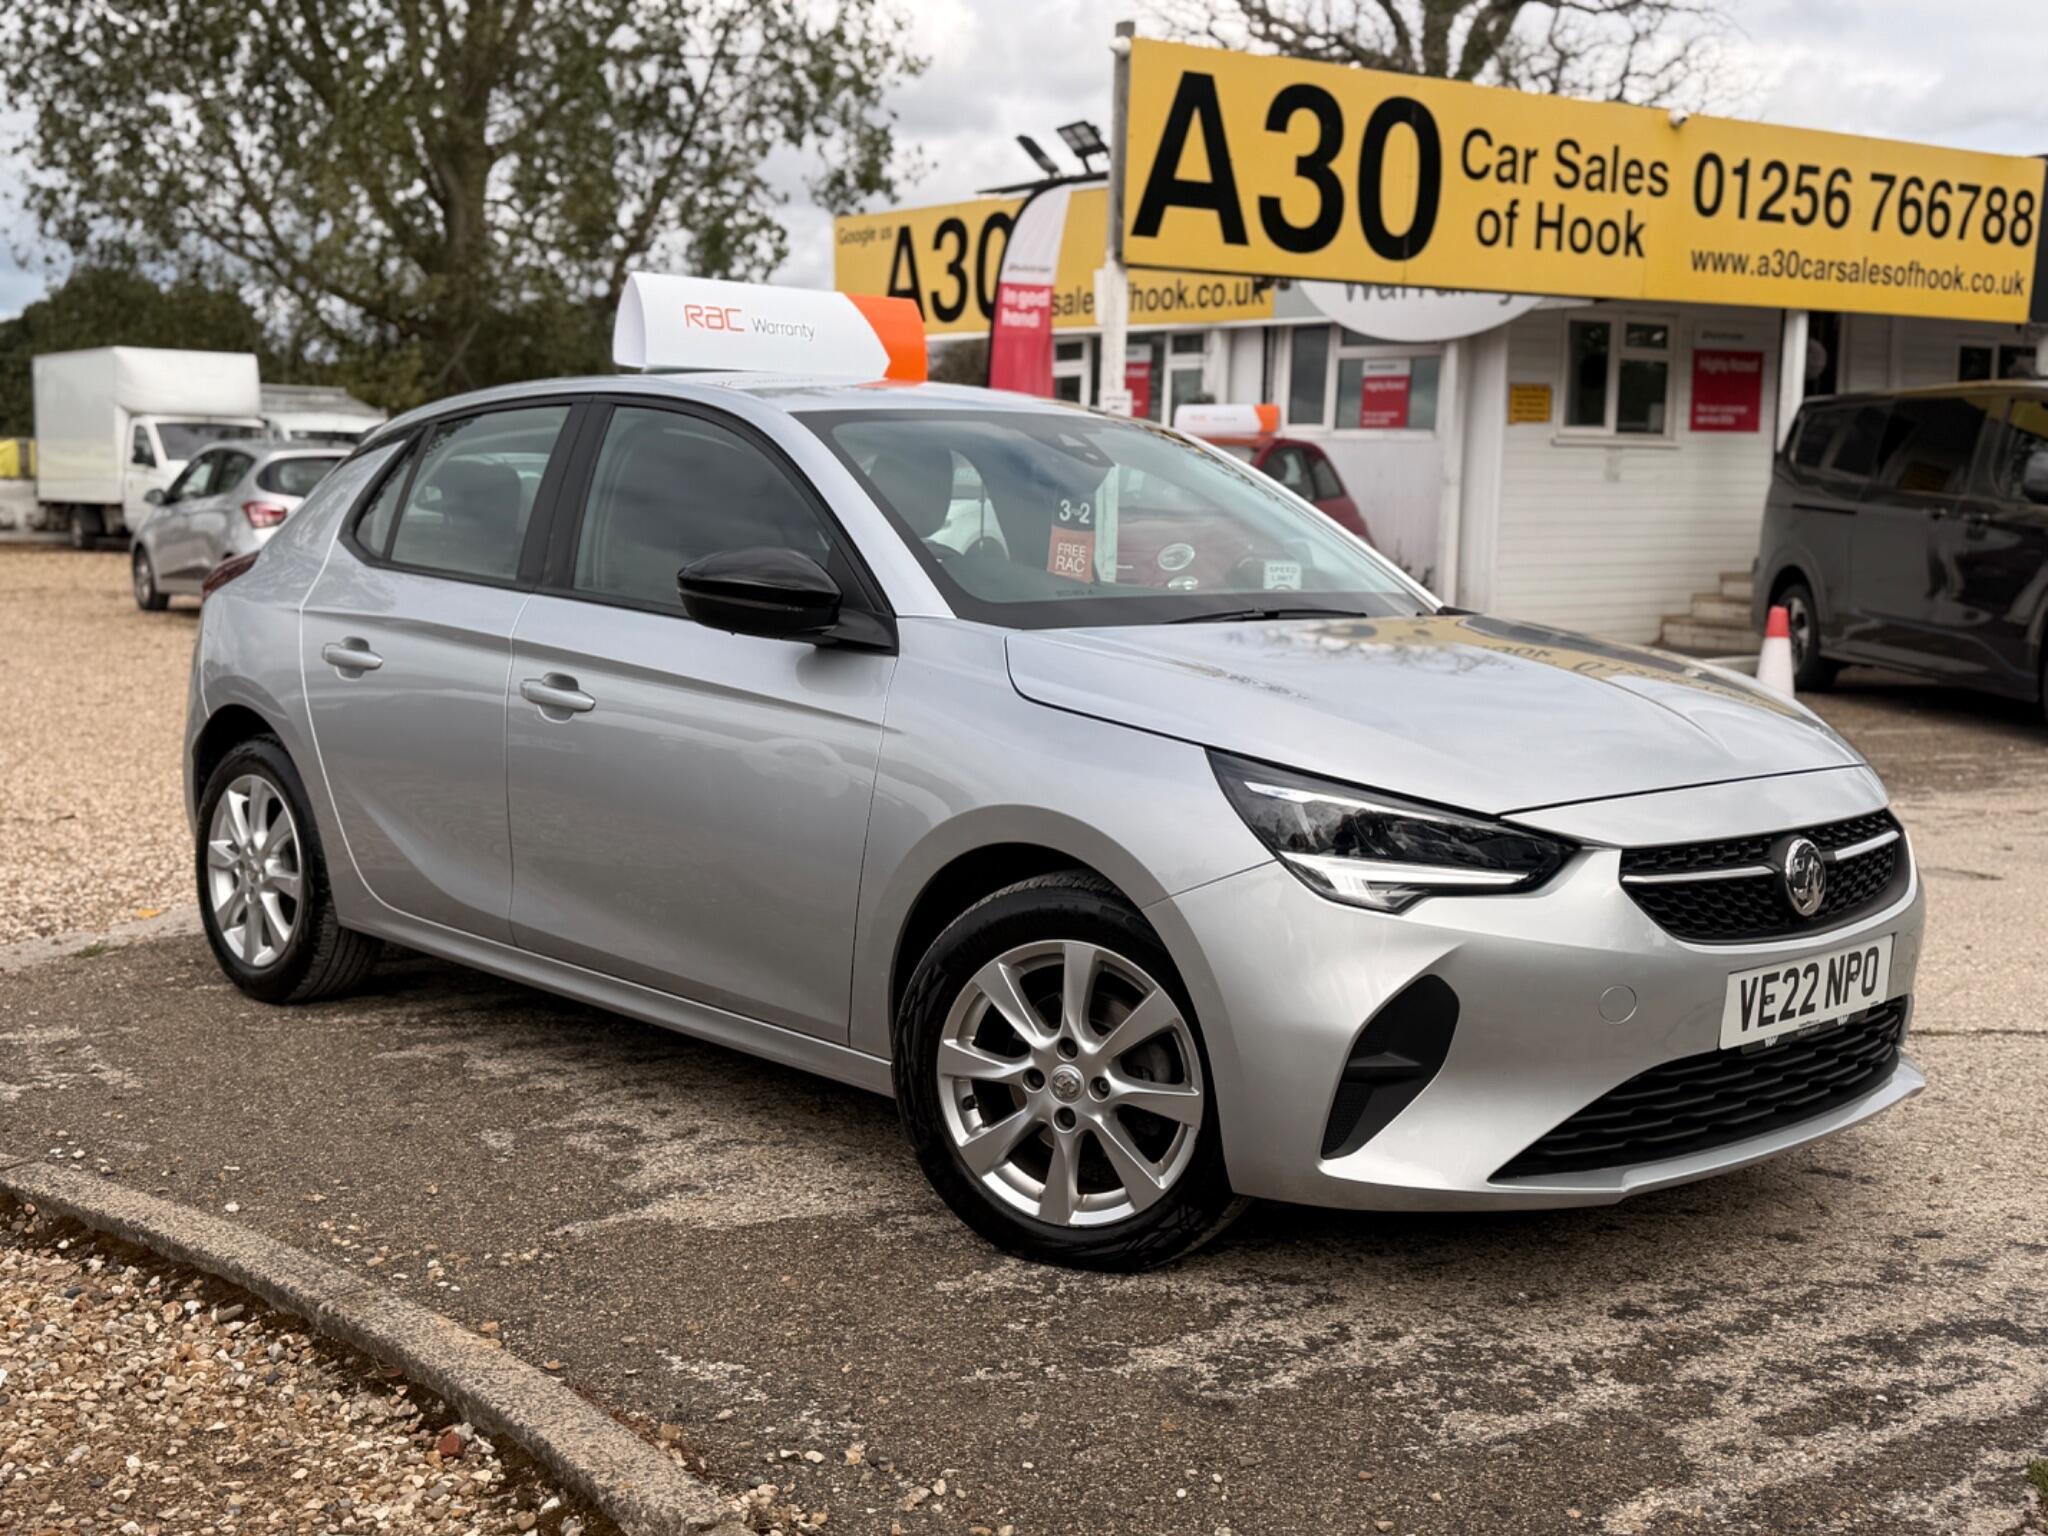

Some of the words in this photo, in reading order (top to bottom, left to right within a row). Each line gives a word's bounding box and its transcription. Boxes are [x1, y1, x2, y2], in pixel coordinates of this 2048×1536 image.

[1130, 70, 1442, 262] A30
[1461, 127, 1539, 185] Car
[1554, 138, 1670, 197] Sales
[1693, 150, 1852, 230] 01256
[1869, 172, 2036, 247] 766788
[1475, 199, 1520, 248] of
[1534, 201, 1646, 258] Hook
[1690, 247, 2026, 296] www.a30carsalesofhook.co.uk
[751, 317, 815, 342] Warranty
[1059, 498, 1071, 521] 3
[1079, 502, 1091, 524] 2
[1055, 555, 1086, 573] RAC
[1057, 542, 1087, 558] FREE
[1740, 962, 1820, 1032] VE22
[1824, 945, 1880, 1010] NPO
